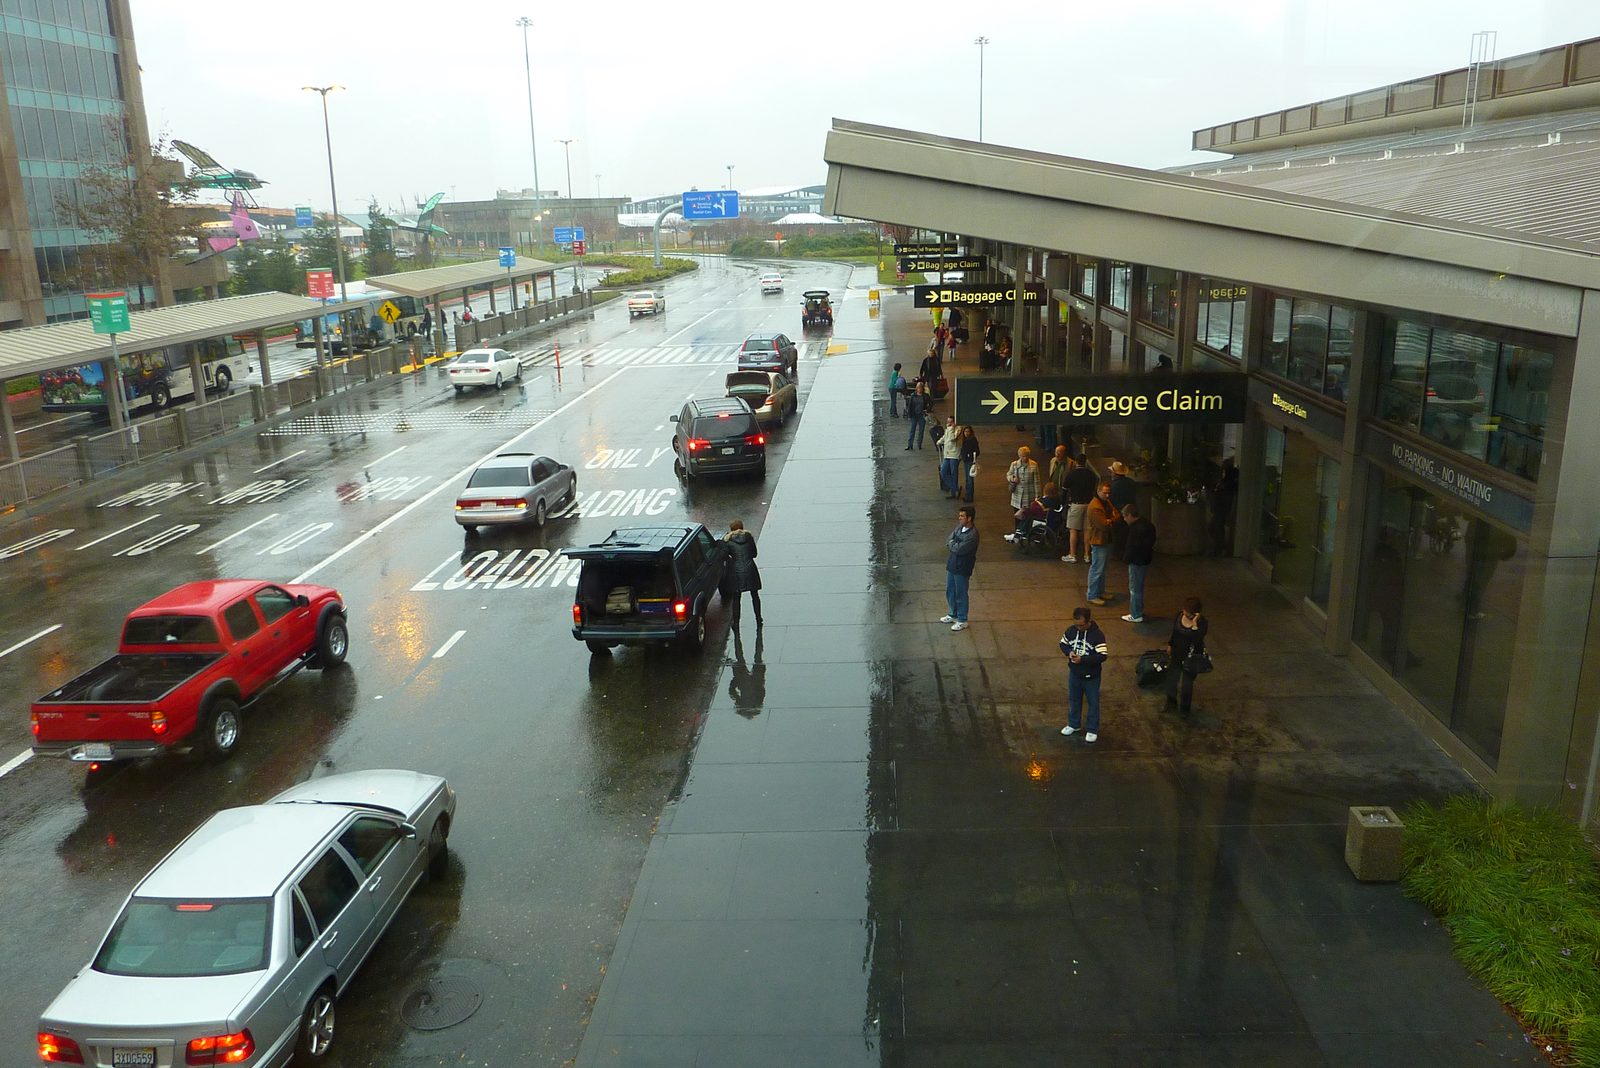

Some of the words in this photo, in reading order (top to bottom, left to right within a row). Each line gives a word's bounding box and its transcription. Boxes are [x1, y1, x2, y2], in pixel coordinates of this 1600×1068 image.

[925, 261, 958, 271] Bagage
[959, 260, 980, 268] Claim
[953, 290, 1003, 304] Baggage
[1005, 289, 1037, 301] Clim
[1041, 391, 1149, 416] Baggage
[1156, 389, 1223, 411] Claim
[1277, 395, 1295, 414] Baggage
[1295, 404, 1307, 419] Claim
[584, 447, 671, 470] ONLY
[1392, 443, 1403, 459] NO
[1404, 449, 1434, 474] PARKING
[1441, 466, 1455, 484] NO
[1457, 473, 1492, 502] WAITING
[546, 488, 677, 519] OADING
